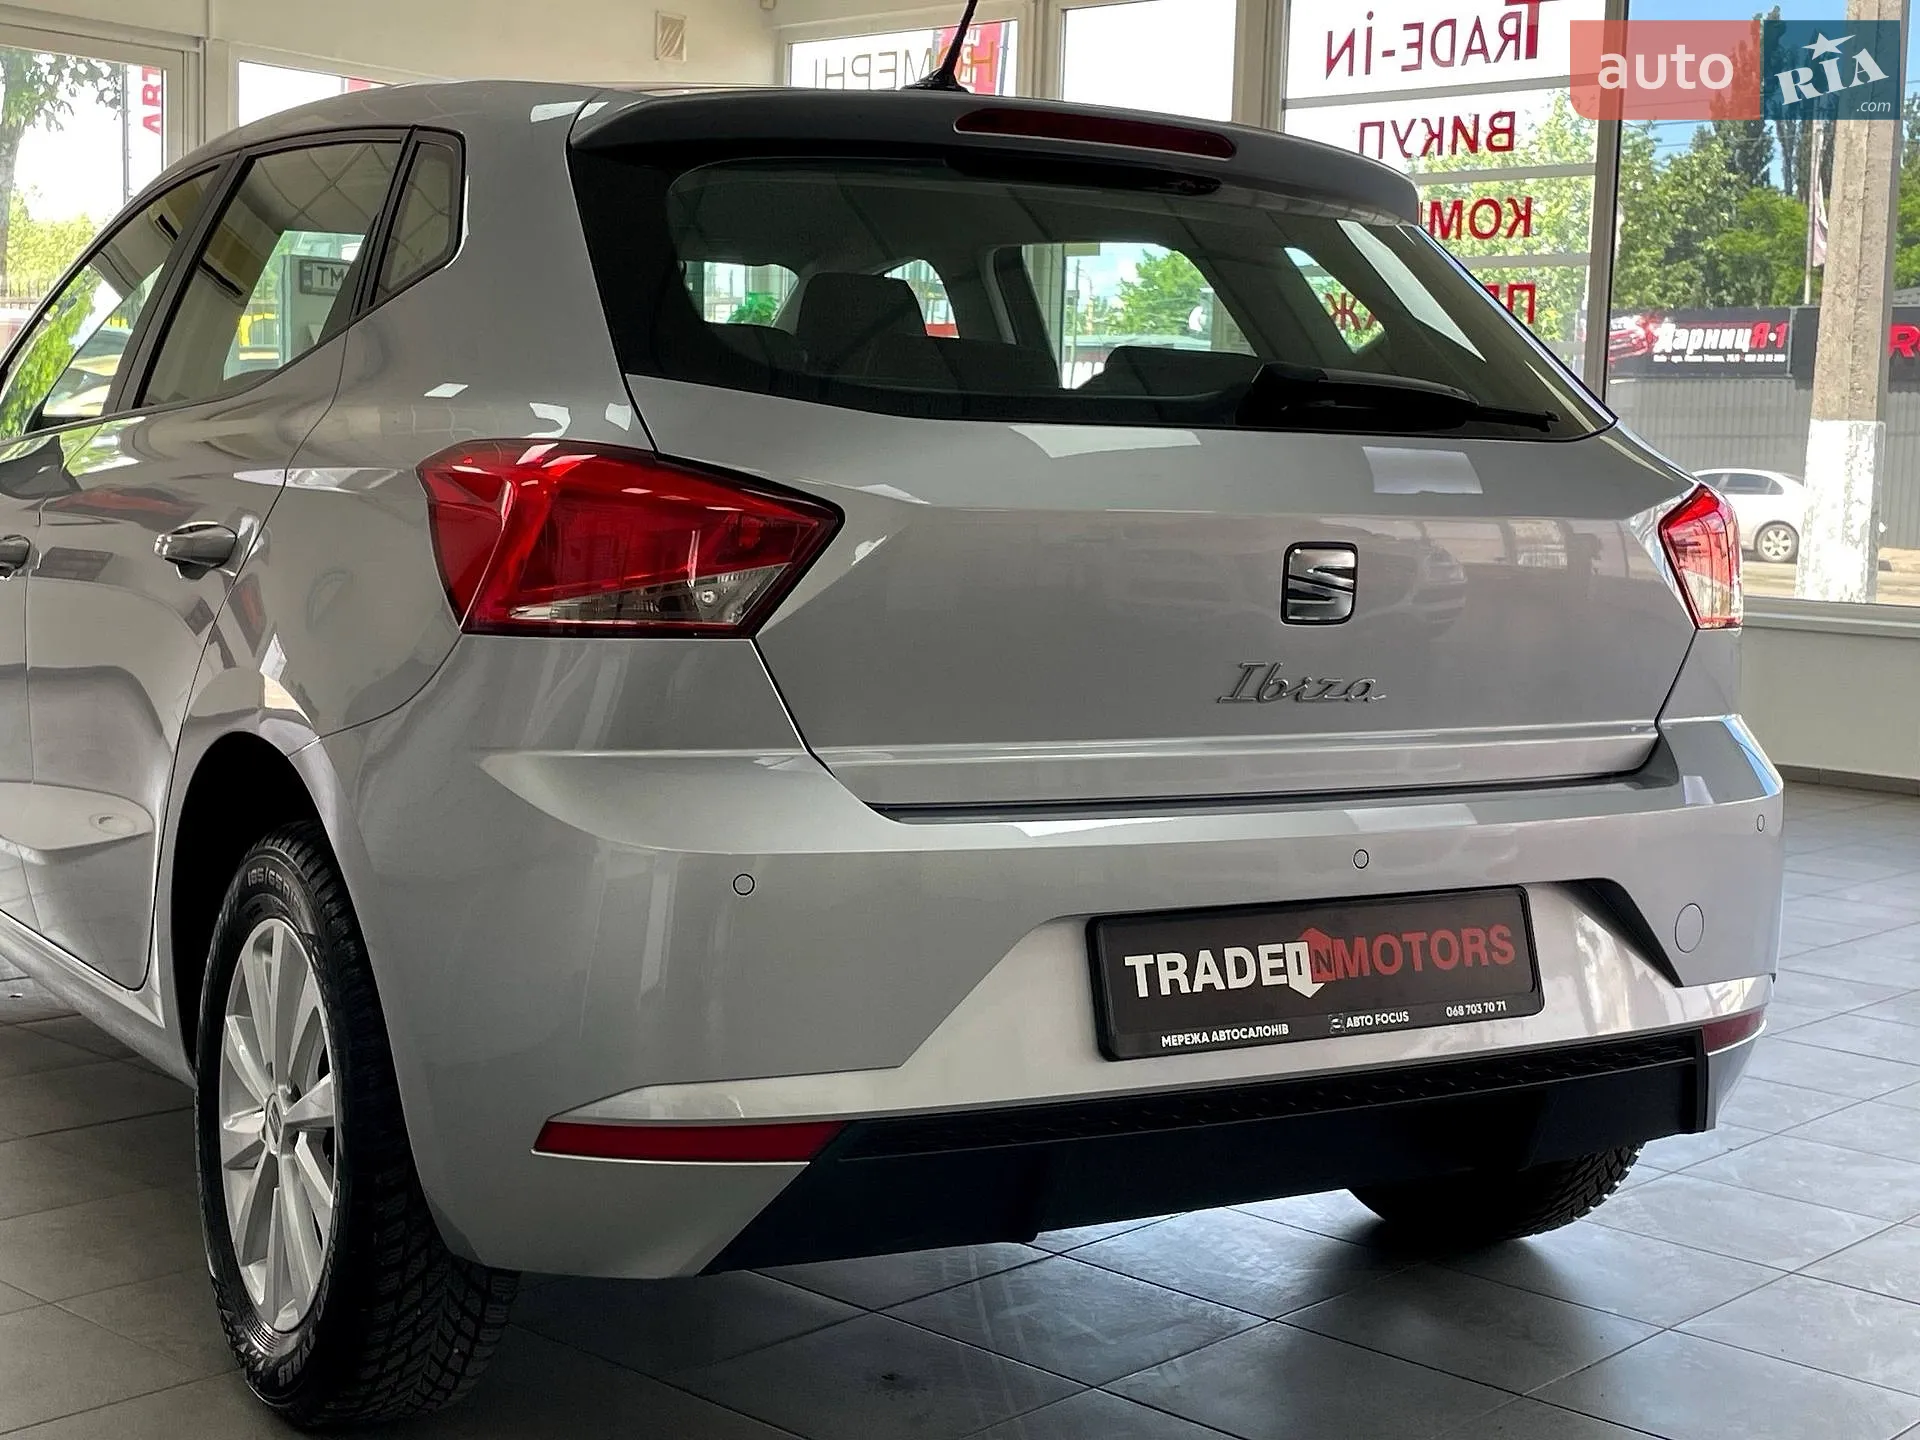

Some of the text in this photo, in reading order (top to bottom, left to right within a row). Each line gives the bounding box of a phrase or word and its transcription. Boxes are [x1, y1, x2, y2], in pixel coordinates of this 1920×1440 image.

[1216, 661, 1387, 703] Ibiza
[1333, 923, 1517, 980] MOTORS
[1375, 1010, 1410, 1026] FOCUS
[1446, 1000, 1507, 1017] 068 703 70 71
[1161, 1023, 1290, 1048] МЕРЕЖА АВТОСАЛОНІВ
